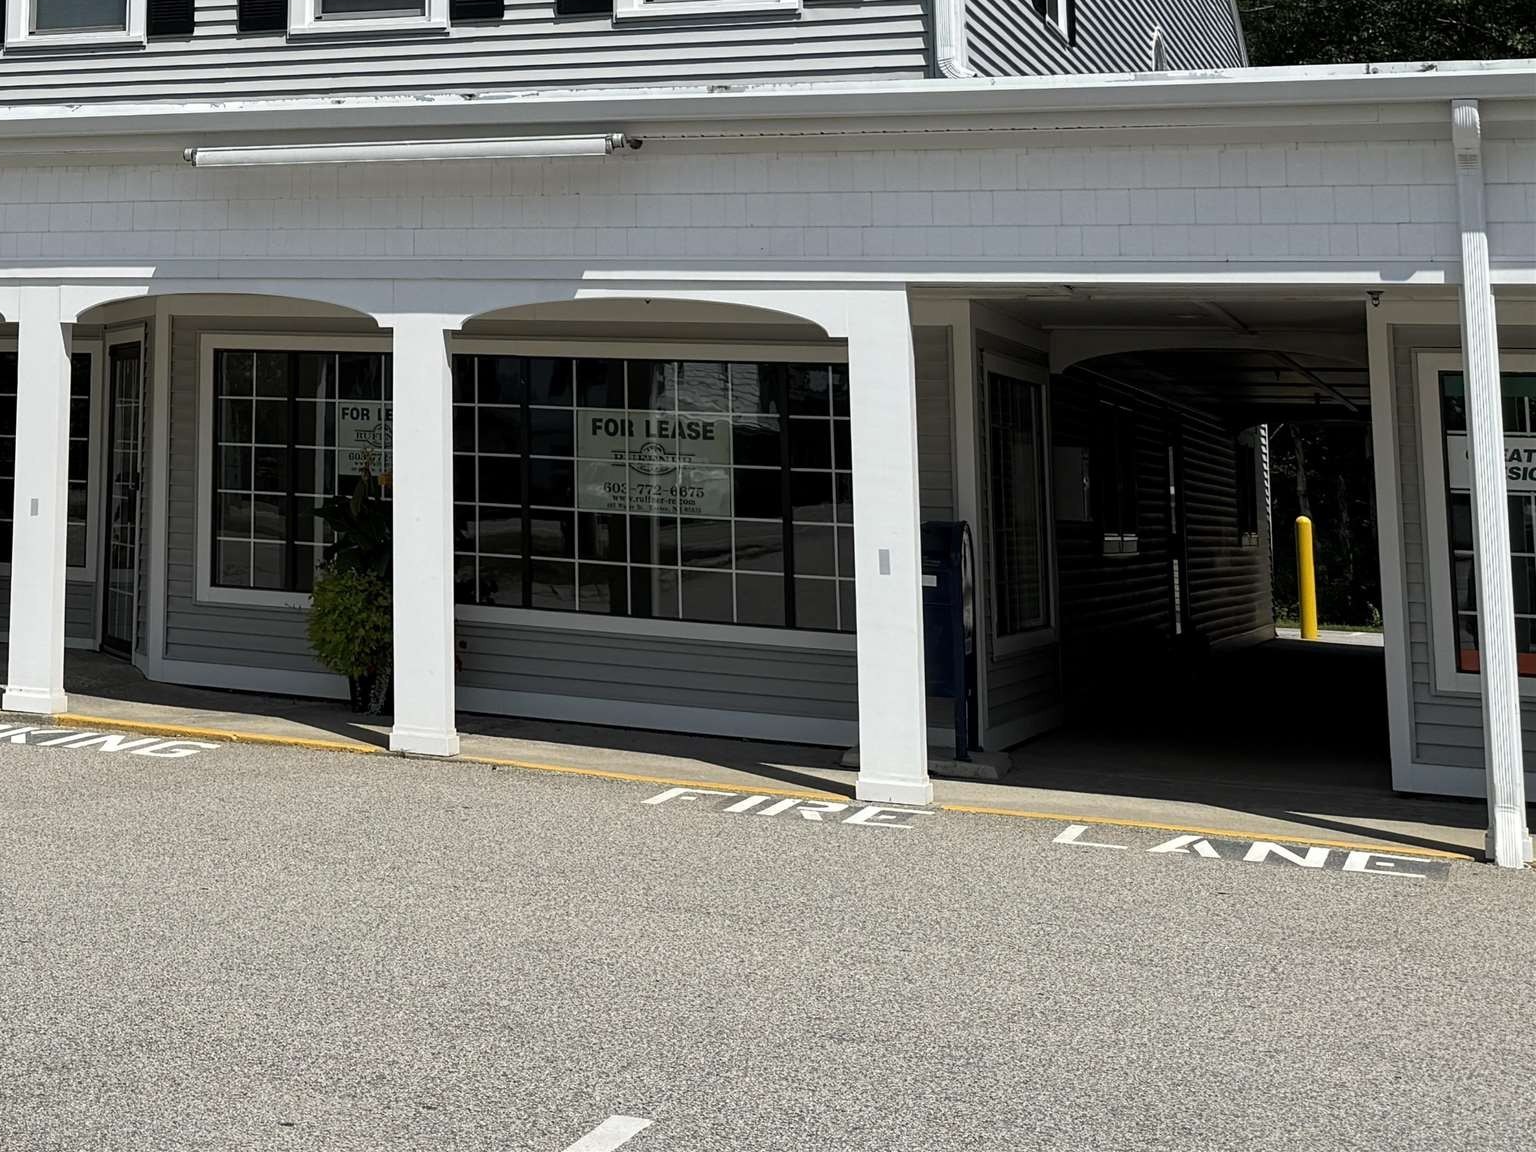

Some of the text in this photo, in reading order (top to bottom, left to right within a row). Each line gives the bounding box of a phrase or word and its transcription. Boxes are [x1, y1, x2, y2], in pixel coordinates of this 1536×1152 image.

[341, 406, 370, 421] FOR
[591, 417, 714, 441] FOR LEASE
[640, 787, 1432, 879] FIRE LANE
